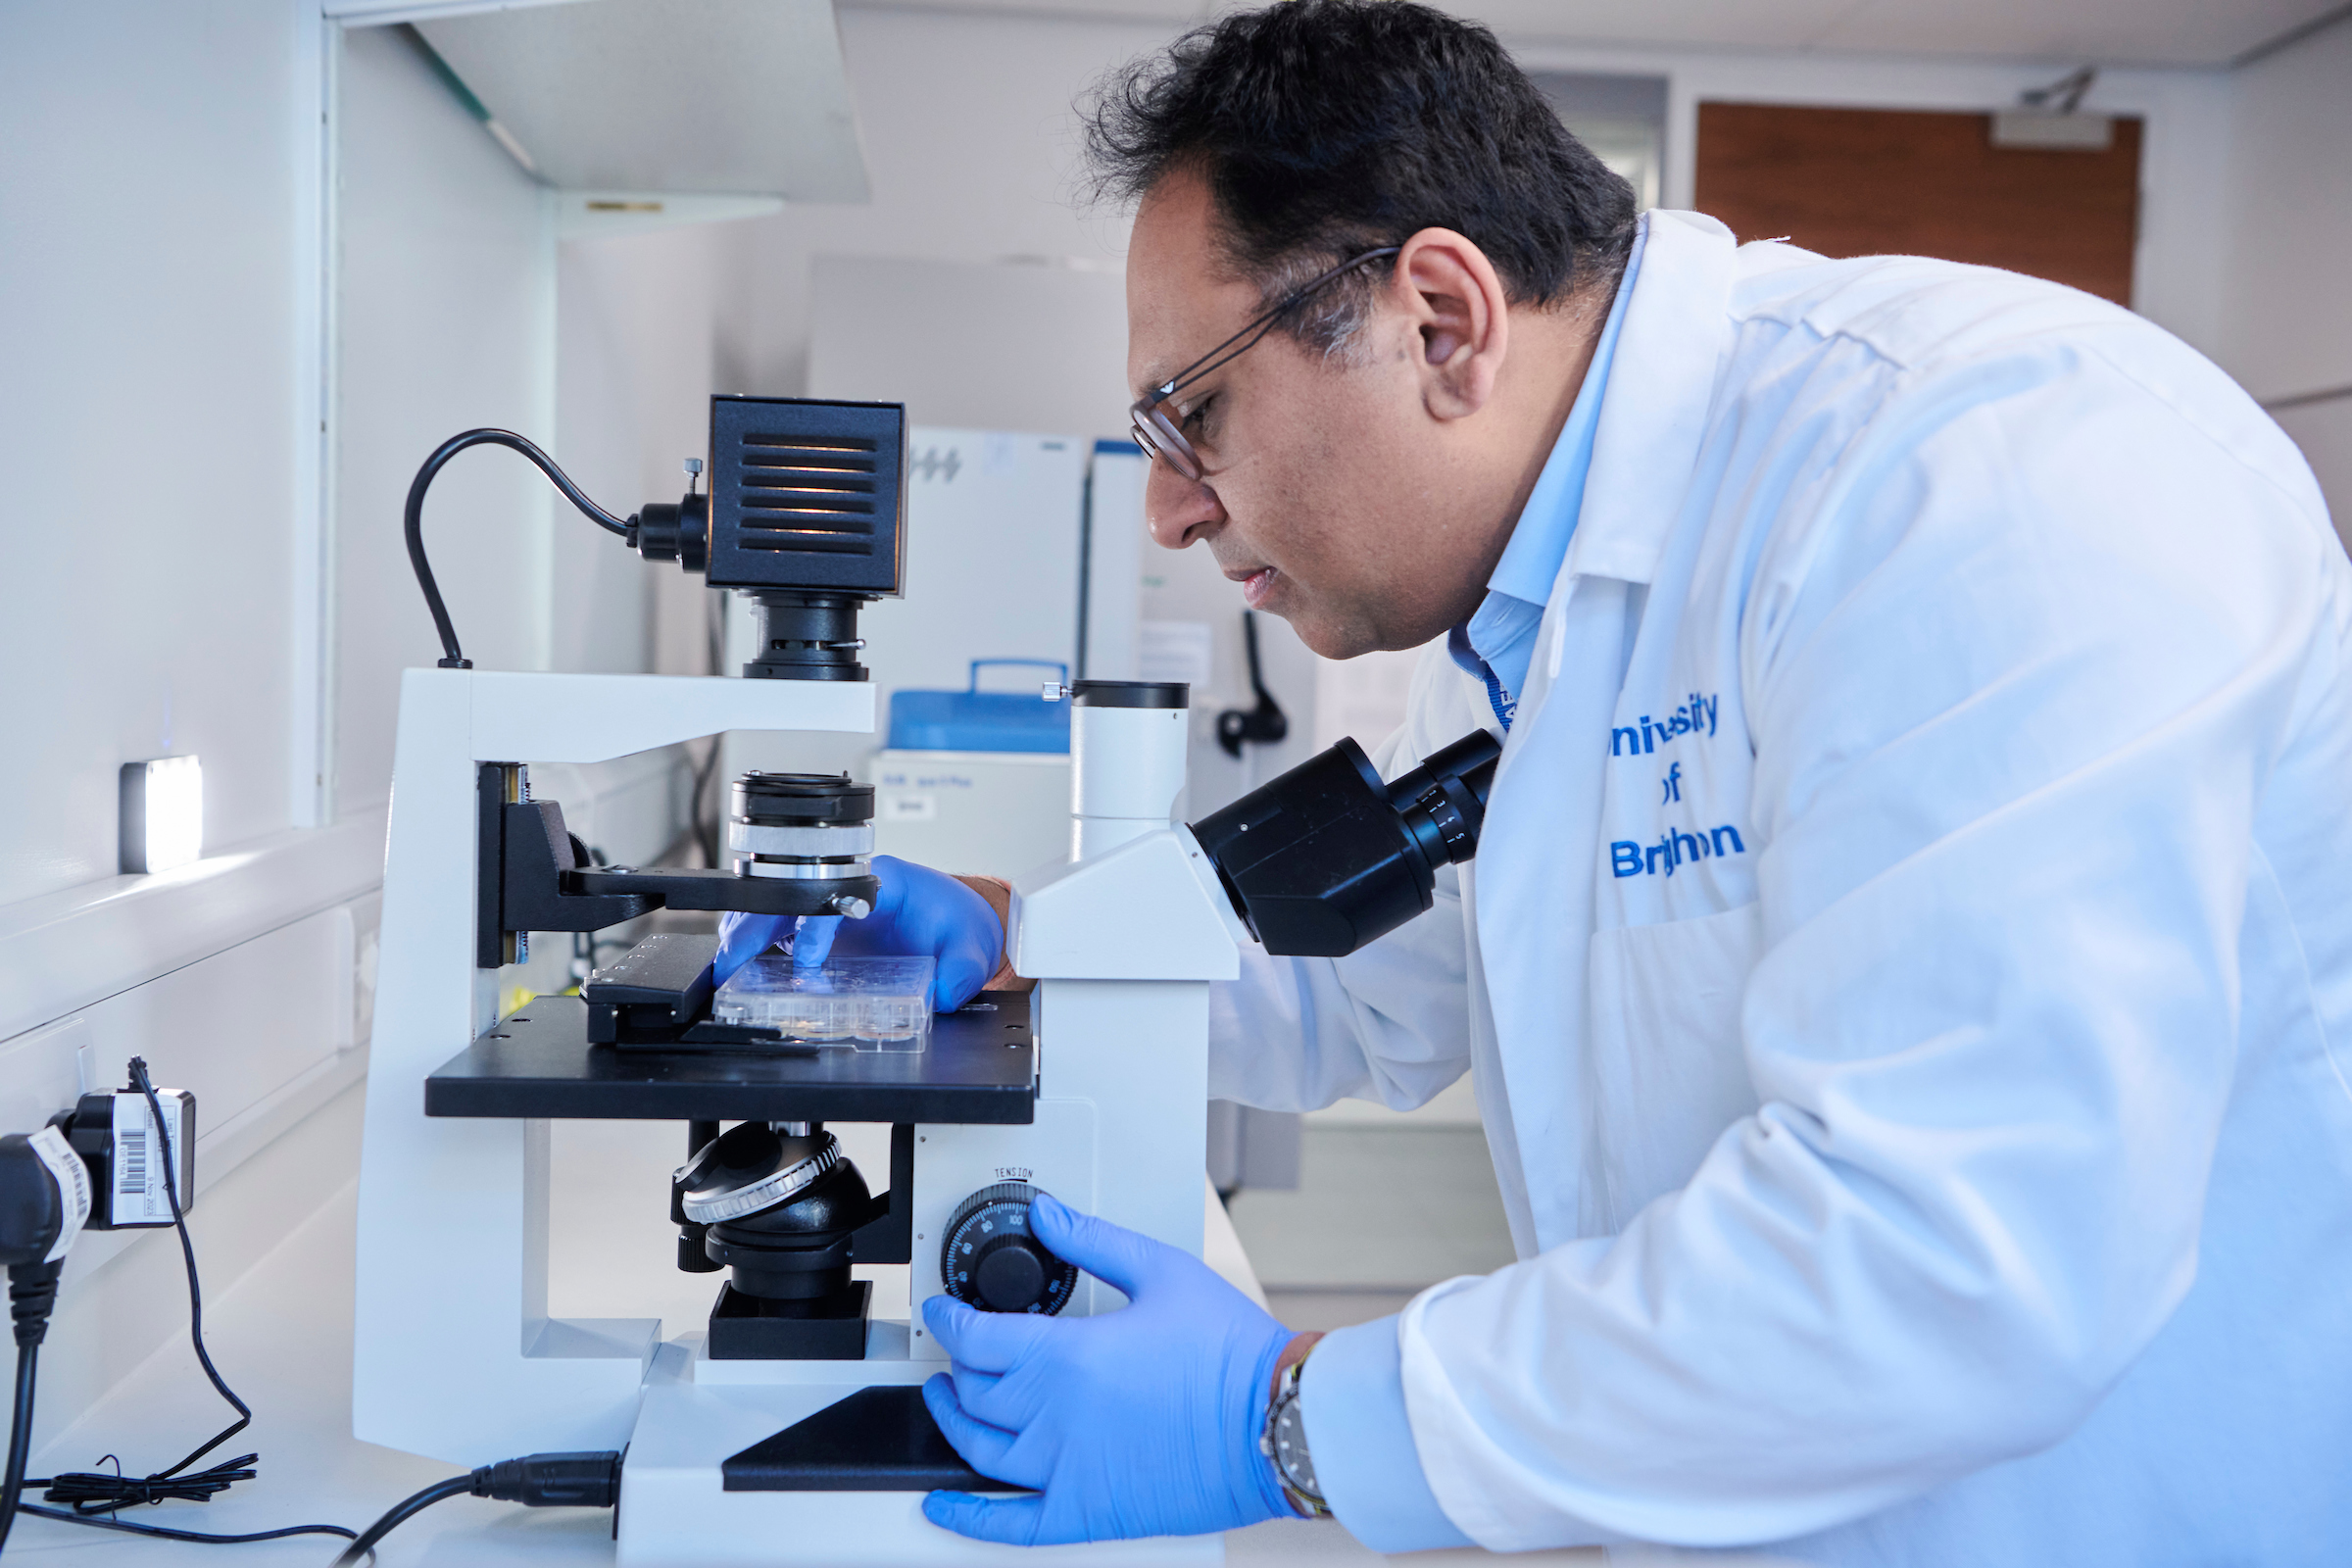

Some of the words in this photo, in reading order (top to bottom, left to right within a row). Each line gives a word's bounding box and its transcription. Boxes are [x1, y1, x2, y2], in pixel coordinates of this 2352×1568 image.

[995, 1167, 1034, 1178] TENSION
[961, 1242, 973, 1254] 60
[981, 1220, 994, 1233] 80
[1008, 1214, 1024, 1226] 100
